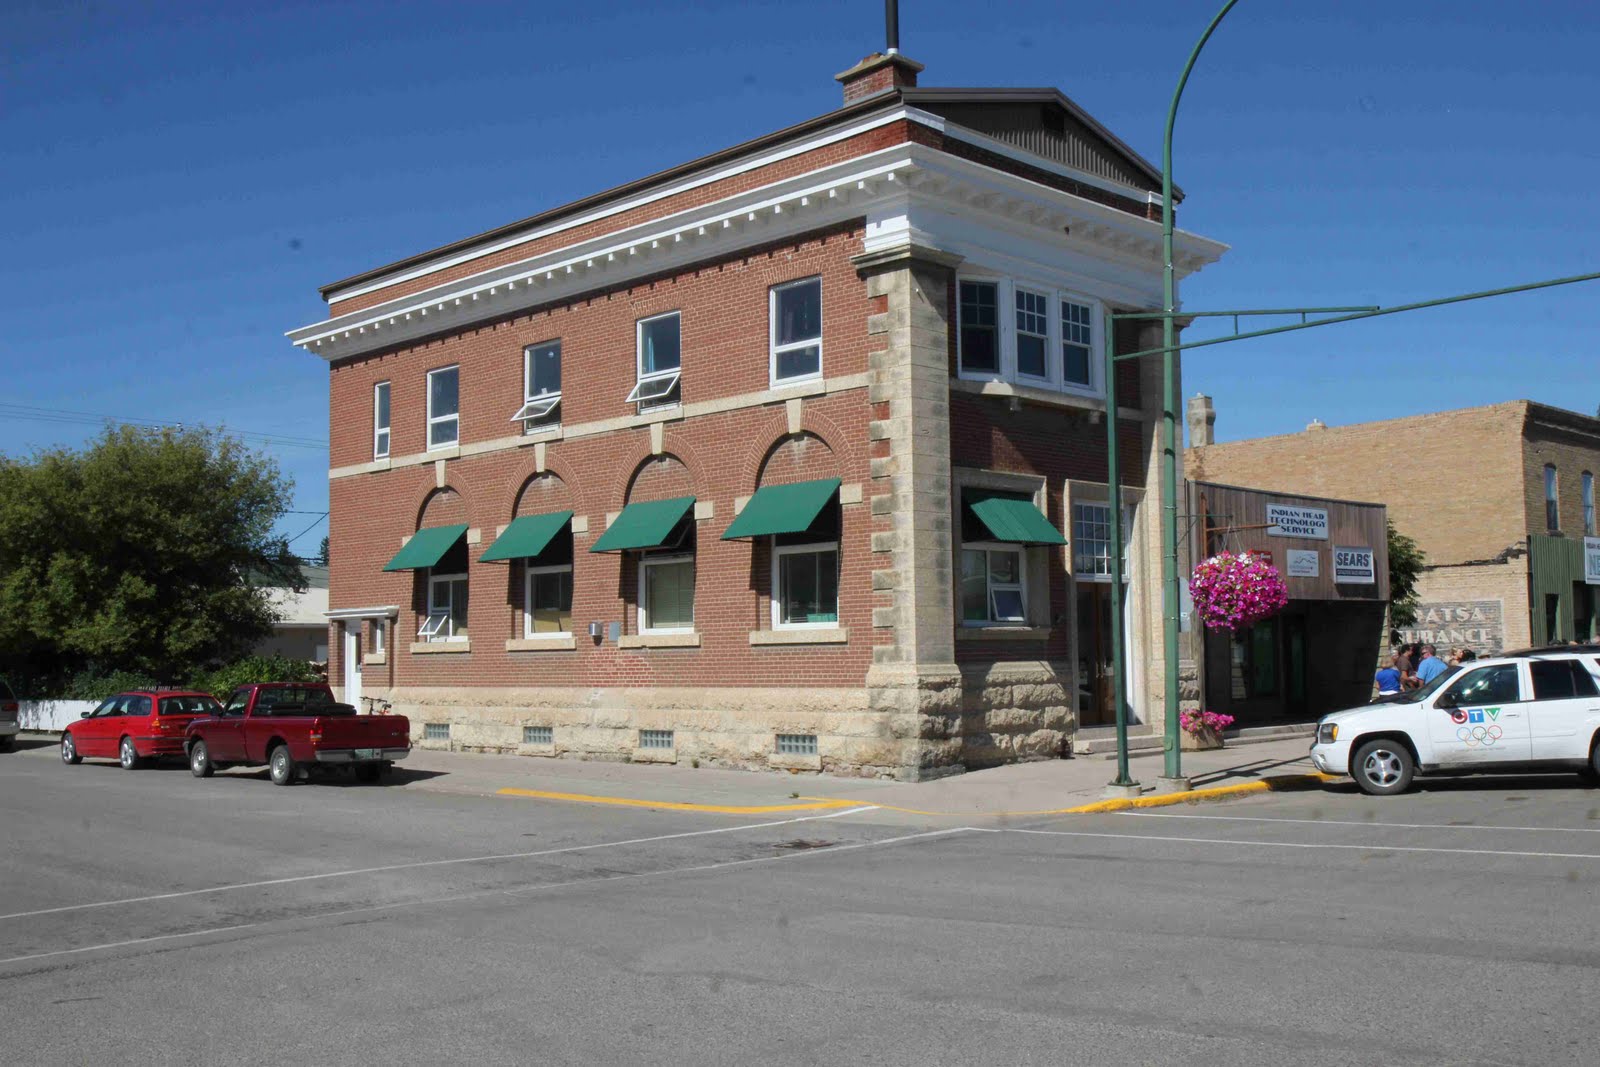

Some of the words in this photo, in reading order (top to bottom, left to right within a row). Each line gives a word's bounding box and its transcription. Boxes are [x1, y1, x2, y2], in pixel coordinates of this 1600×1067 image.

[1271, 508, 1300, 518] INDIAN
[1303, 510, 1325, 520] HEAD
[1270, 516, 1326, 528] TECHNOLOGY
[1280, 525, 1316, 535] SERVICE
[1336, 552, 1370, 567] SEARS
